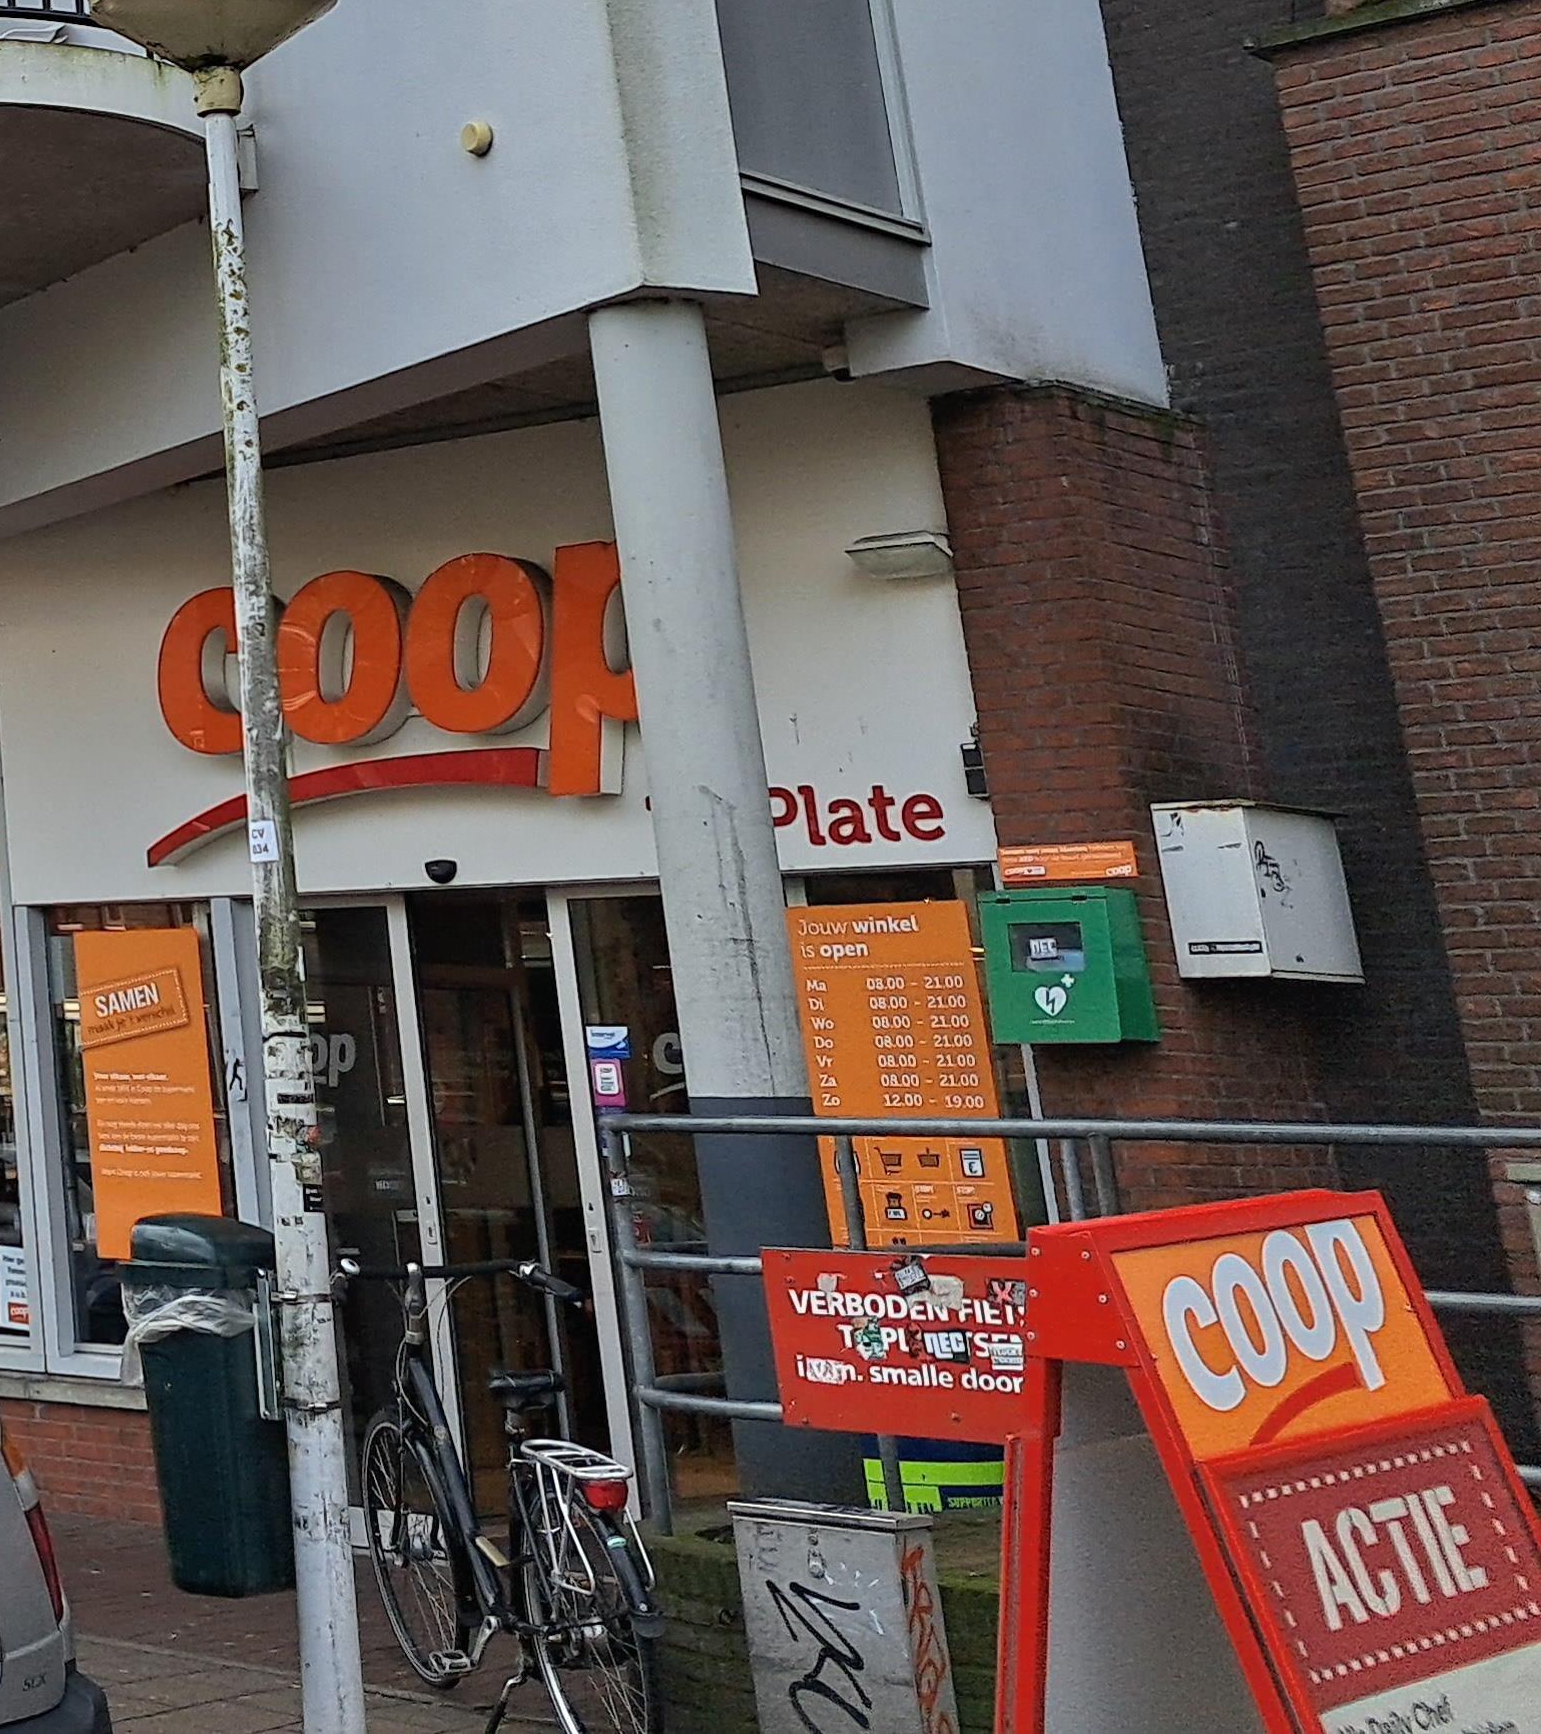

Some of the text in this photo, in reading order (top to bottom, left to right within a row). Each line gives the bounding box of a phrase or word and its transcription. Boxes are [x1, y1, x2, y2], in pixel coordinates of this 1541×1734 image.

[157, 541, 639, 795] coop
[768, 785, 946, 846] Plate
[798, 915, 919, 936] Jouw winkel
[801, 943, 868, 962] is open
[806, 979, 827, 992] Ma
[866, 977, 905, 990] 08.00
[924, 976, 964, 989] 21.00
[95, 982, 160, 1018] SAMEN
[808, 998, 824, 1011] Di
[869, 996, 908, 1010] 08.00
[927, 995, 966, 1009] 21.00
[810, 1018, 835, 1030] Wo
[872, 1016, 911, 1029] 08.00
[930, 1015, 969, 1028] 21.00
[814, 1037, 834, 1049] Do
[875, 1035, 914, 1048] 08.00
[933, 1035, 973, 1048] 21.00
[816, 1055, 834, 1068] Vr
[878, 1054, 917, 1067] 08.00
[936, 1054, 976, 1067] 21.00
[819, 1074, 837, 1087] Za
[880, 1074, 919, 1087] 08.00
[939, 1074, 979, 1087] 21.00
[822, 1093, 842, 1107] Zo
[884, 1094, 923, 1107] 12.00
[945, 1095, 984, 1108] 19.00
[788, 1289, 1025, 1327] VERBODEN FIET
[1162, 1220, 1386, 1412] coop
[870, 1365, 954, 1390] smalle
[960, 1368, 1024, 1394] door
[1301, 1485, 1490, 1632] ACTIE
